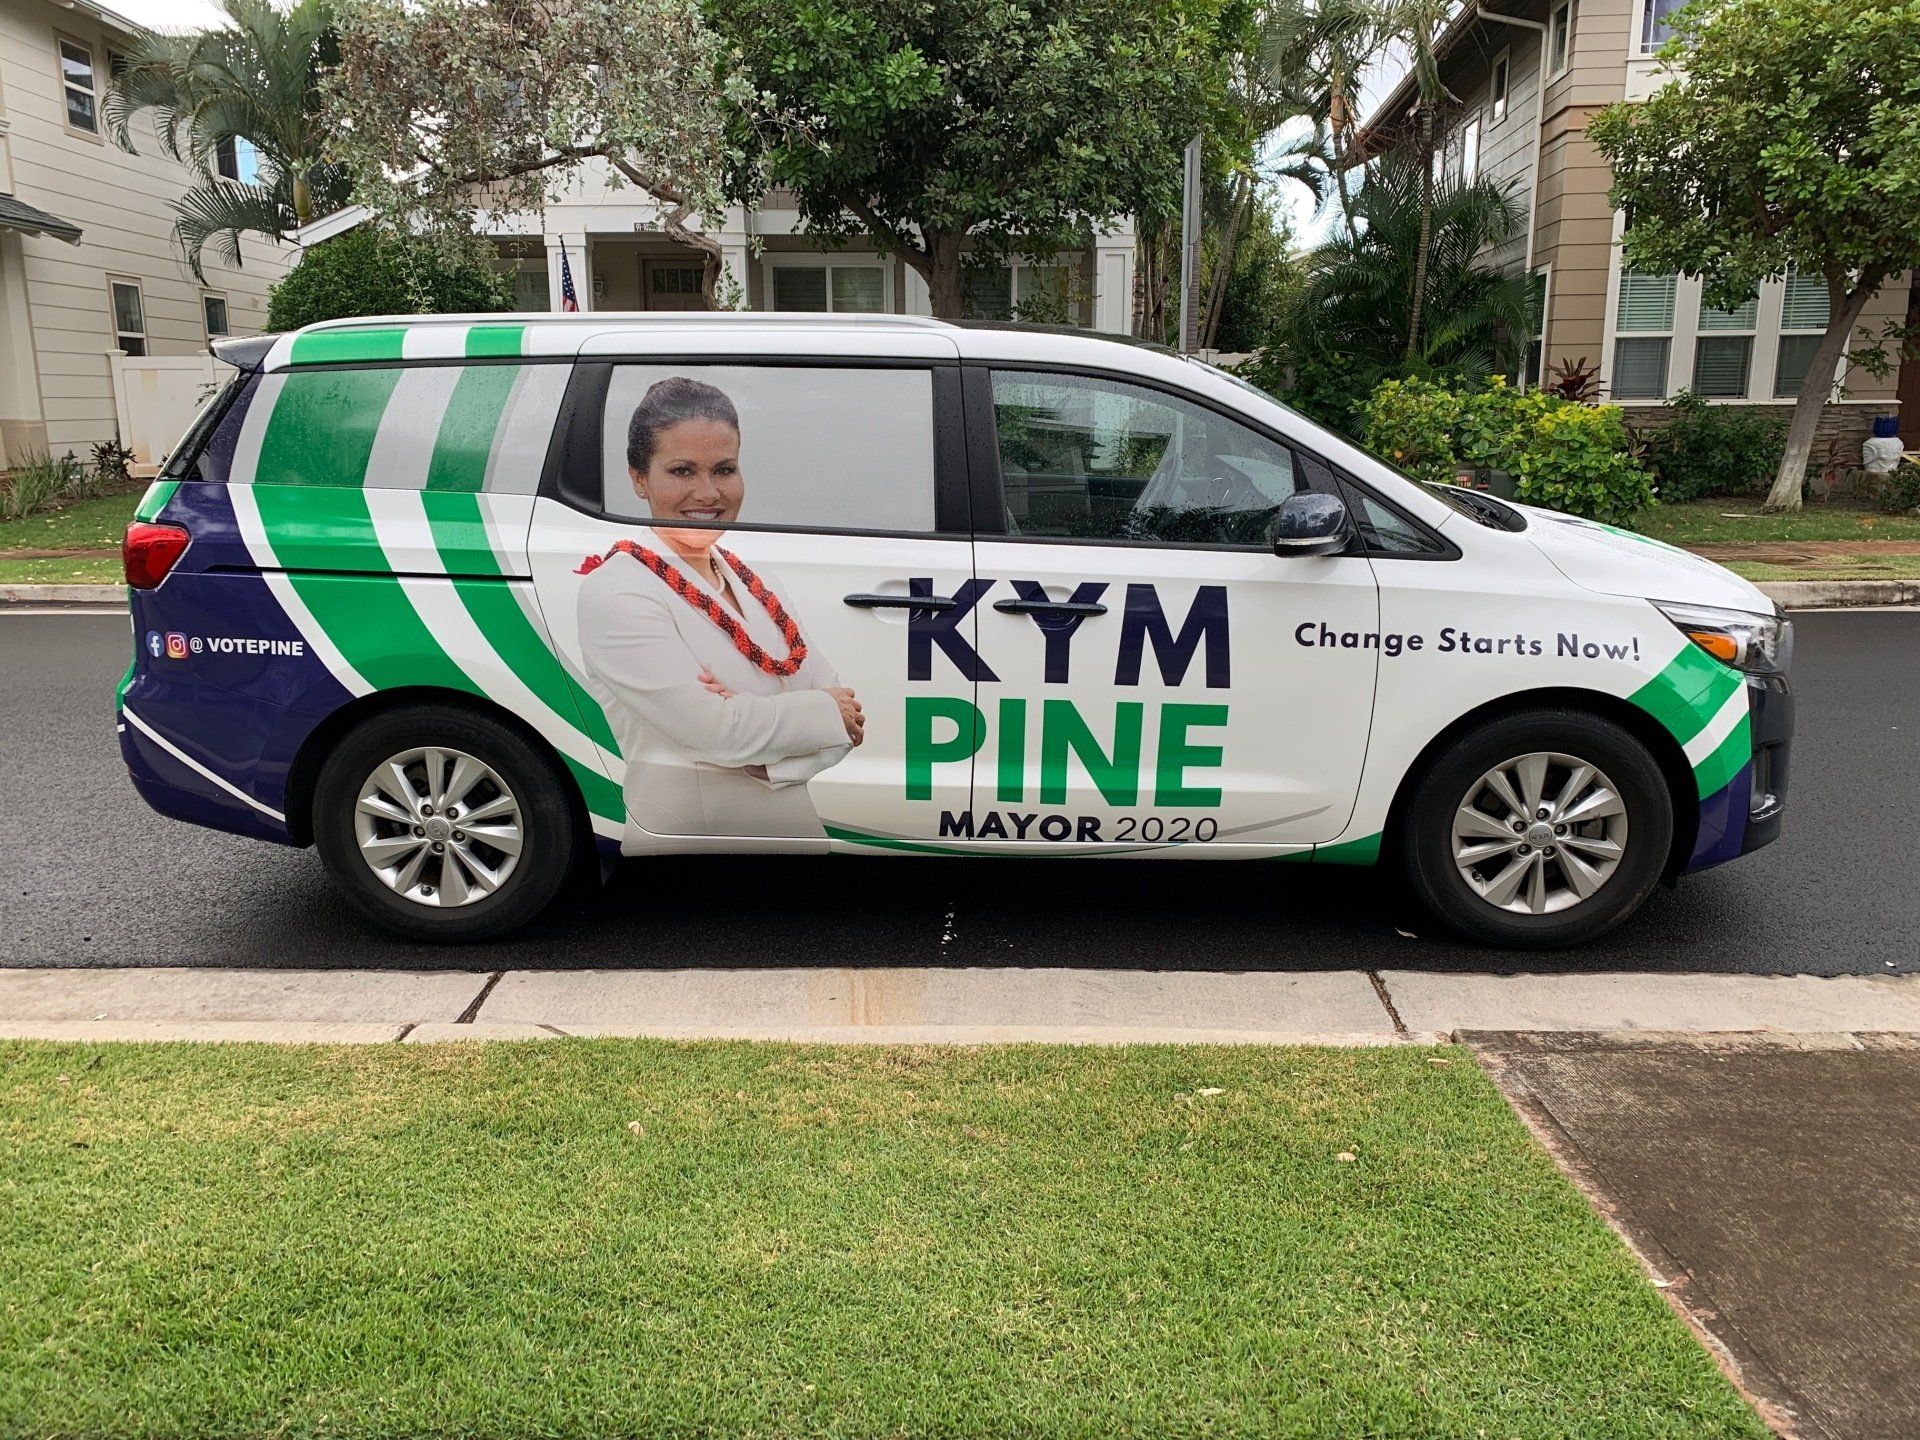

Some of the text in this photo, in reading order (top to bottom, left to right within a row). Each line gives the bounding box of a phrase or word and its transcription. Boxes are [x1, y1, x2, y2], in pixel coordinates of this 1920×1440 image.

[206, 637, 304, 656] VOTEPINE
[907, 577, 1231, 688] KYM
[1294, 622, 1641, 661] Change Starts Now!
[905, 697, 1229, 807] PINE
[938, 810, 1219, 842] MAYOR 2020
